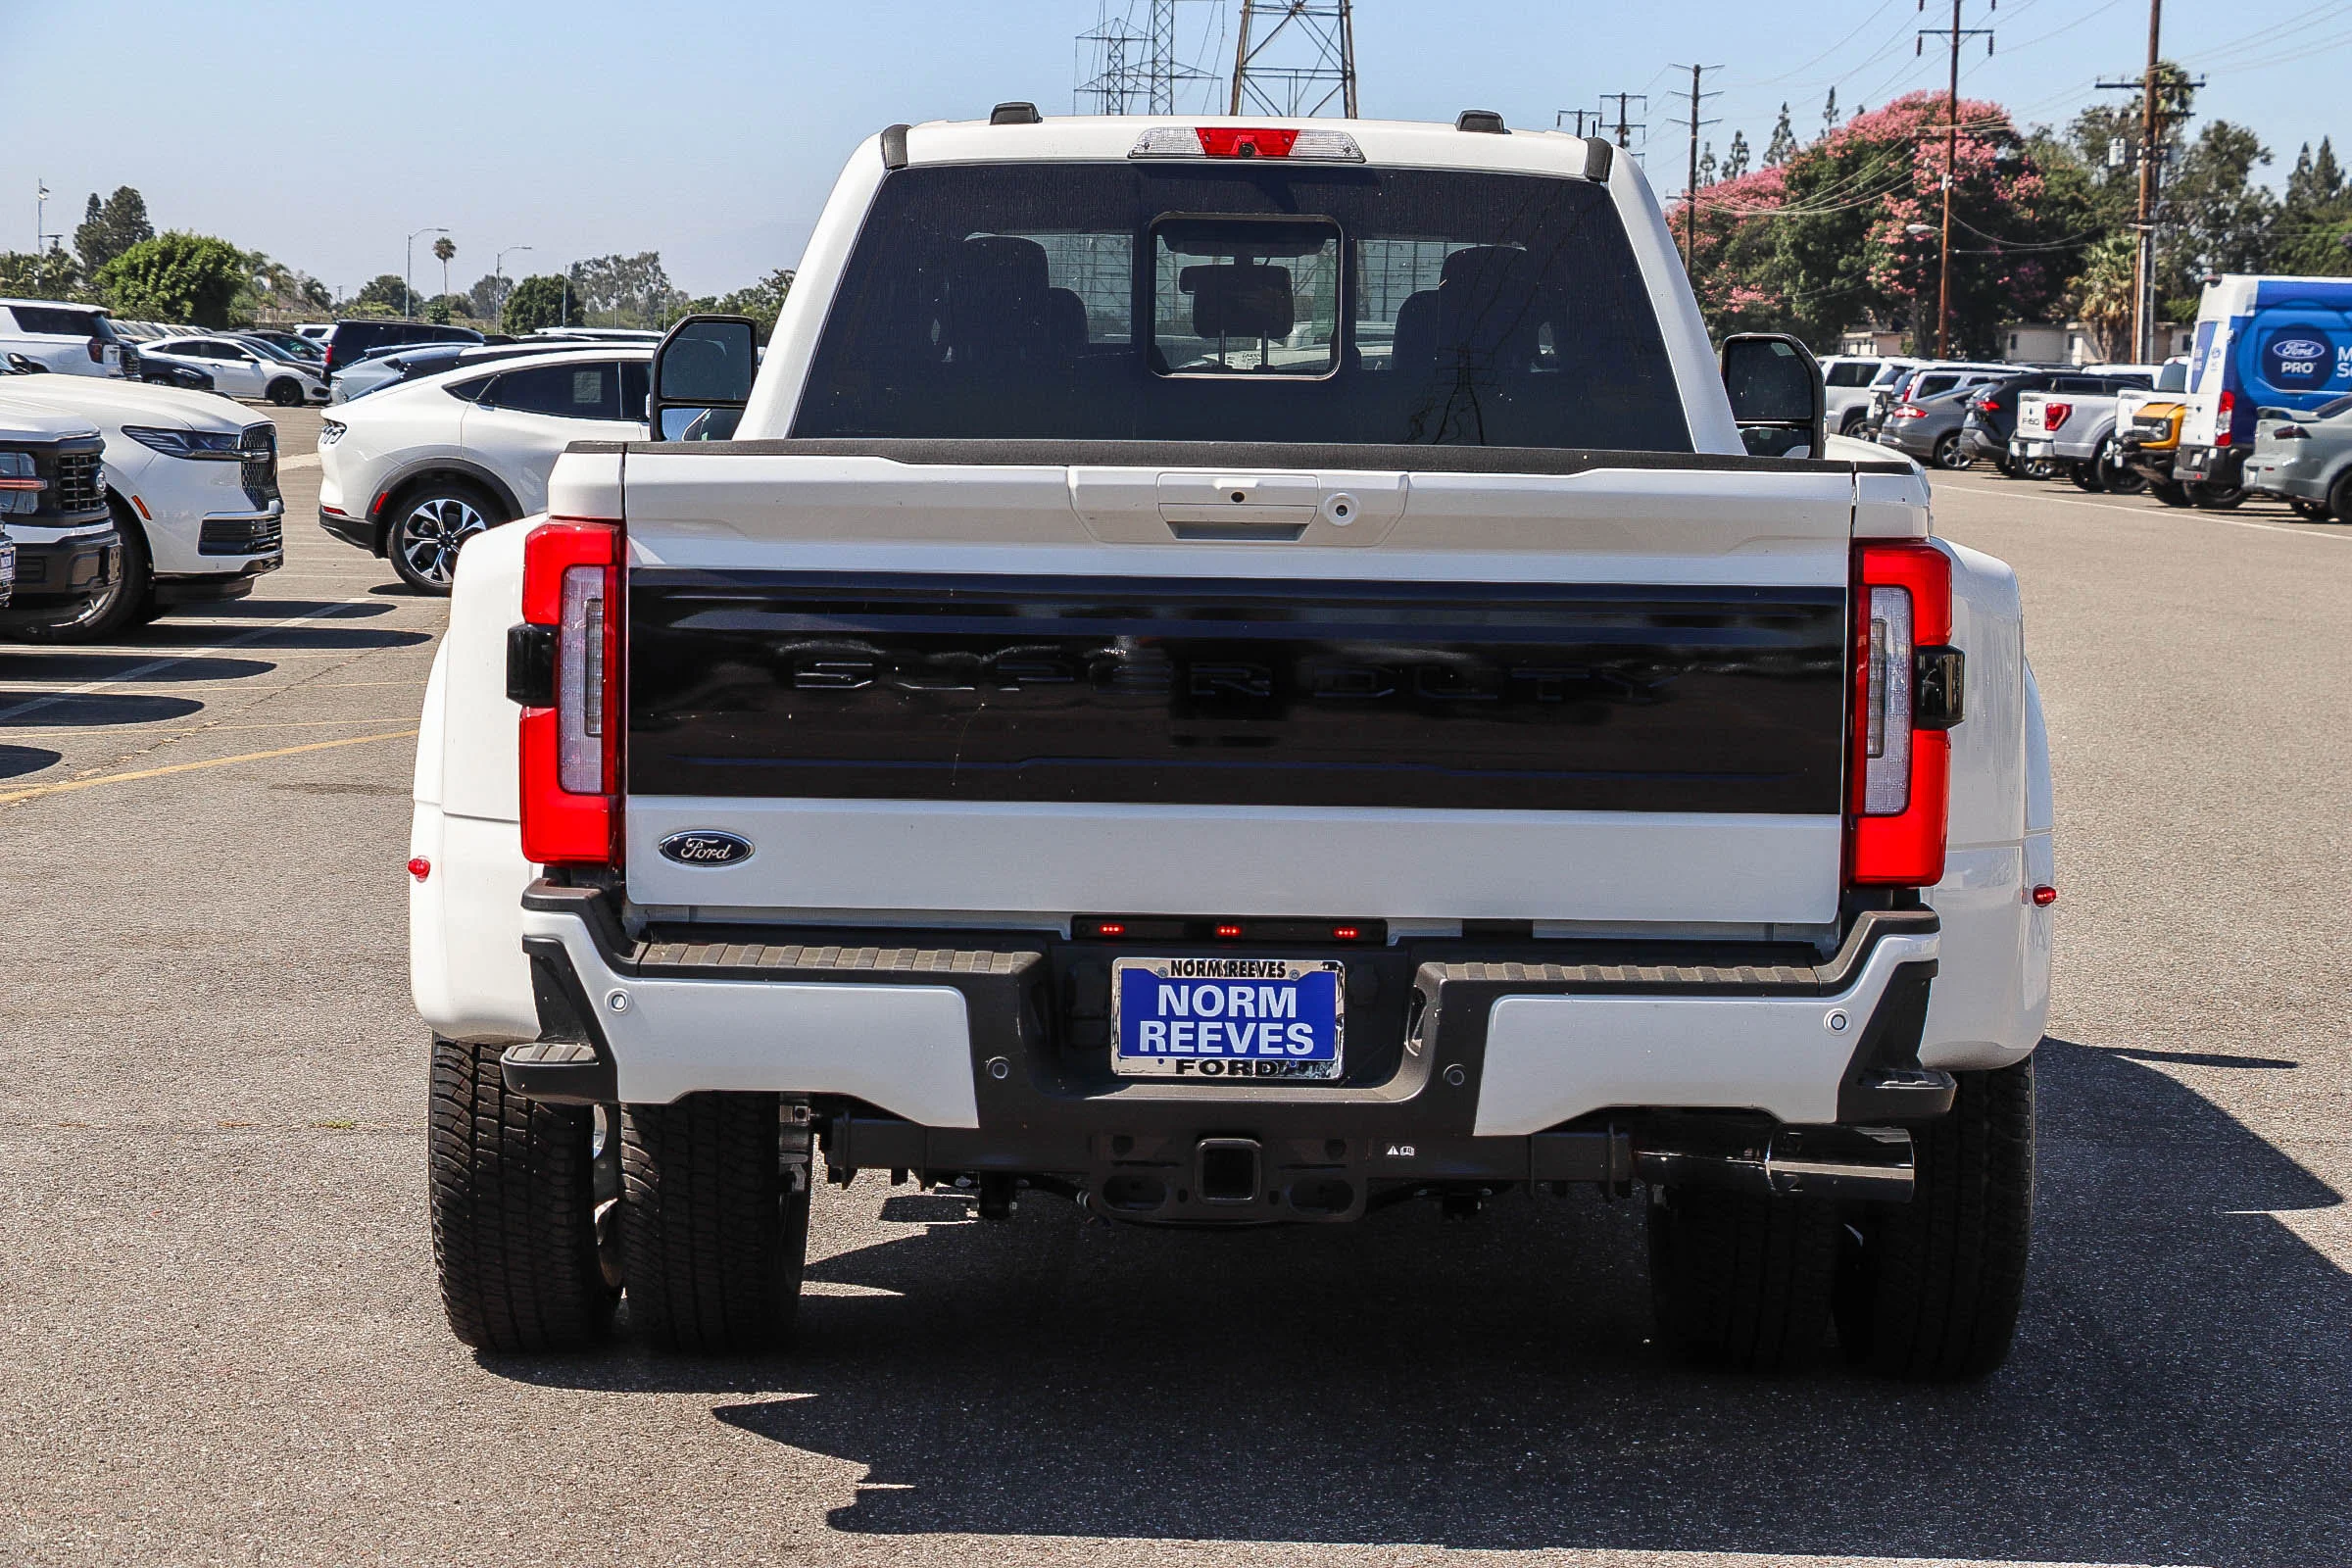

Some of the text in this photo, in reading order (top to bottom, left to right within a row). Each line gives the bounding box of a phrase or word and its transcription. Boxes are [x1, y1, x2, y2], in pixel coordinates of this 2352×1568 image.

[2281, 341, 2315, 356] Ford
[2281, 362, 2314, 373] PRO
[2336, 362, 2352, 377] S
[680, 838, 731, 858] Ford
[1170, 959, 1286, 978] NORM REEVES
[1157, 985, 1297, 1018] NORM
[1139, 1020, 1314, 1055] REEVES
[1175, 1059, 1279, 1076] FORD
